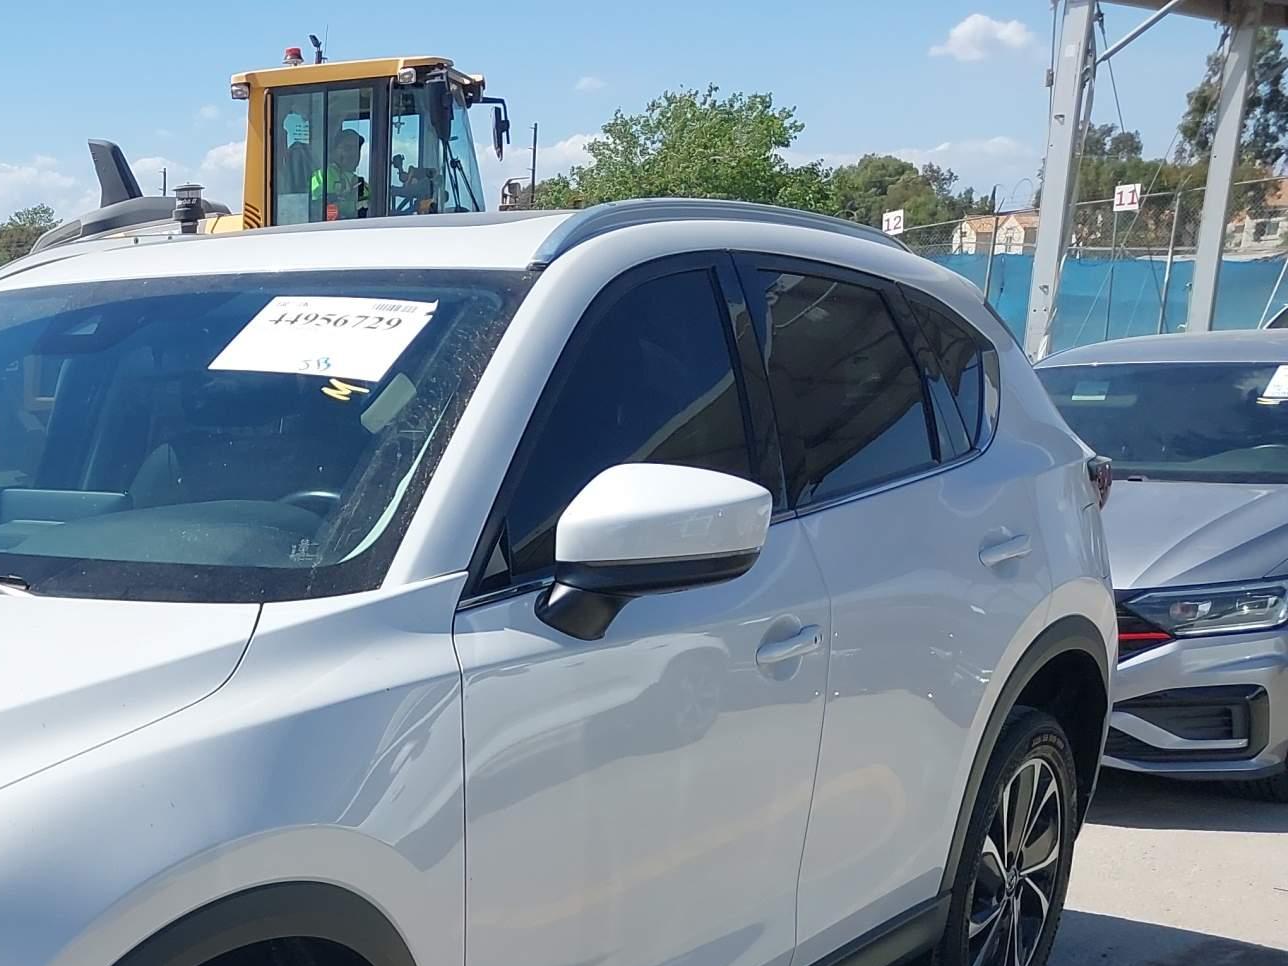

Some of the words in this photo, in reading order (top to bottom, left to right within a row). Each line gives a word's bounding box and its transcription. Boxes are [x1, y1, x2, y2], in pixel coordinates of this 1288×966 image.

[1116, 190, 1137, 207] 11
[885, 215, 902, 233] 12
[269, 312, 403, 331] 44956729
